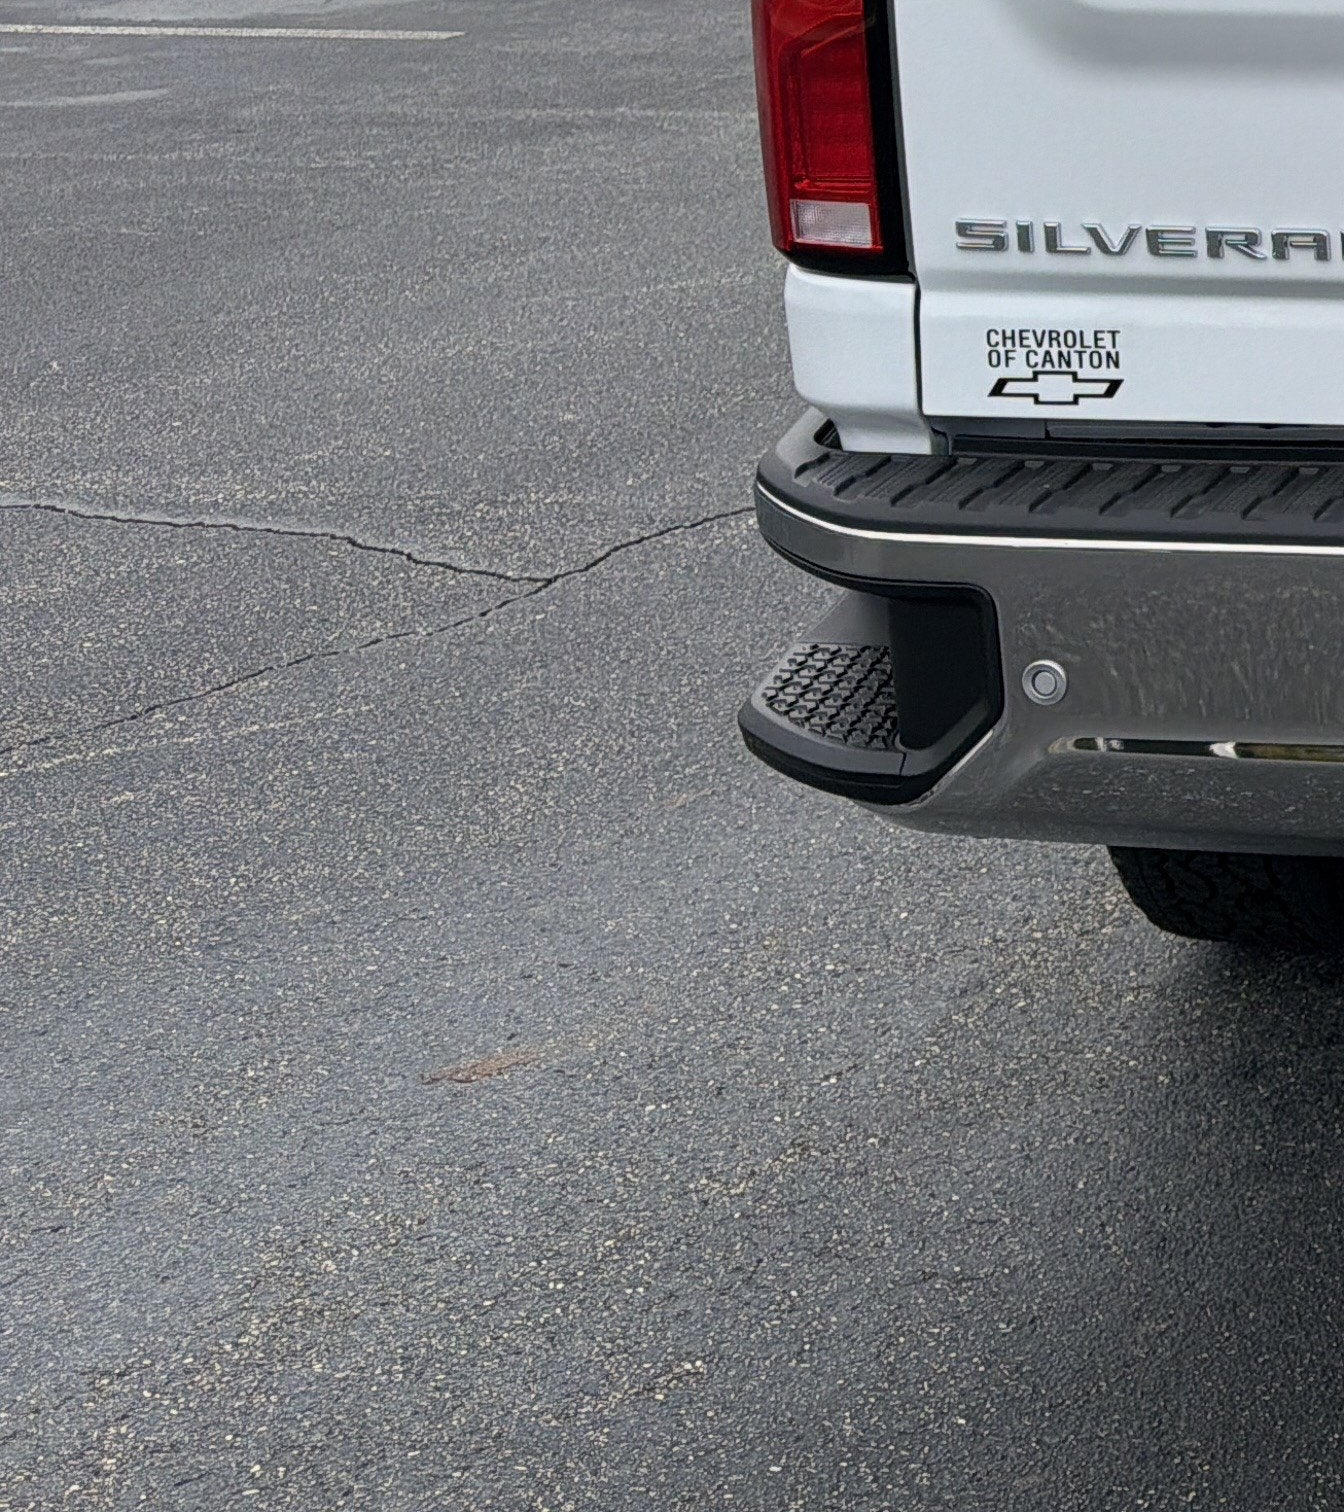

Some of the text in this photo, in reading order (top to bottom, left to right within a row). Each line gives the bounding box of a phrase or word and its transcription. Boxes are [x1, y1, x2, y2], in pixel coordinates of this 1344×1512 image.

[985, 328, 1121, 350] CHEVROLET
[986, 349, 1121, 370] OF CANTON
